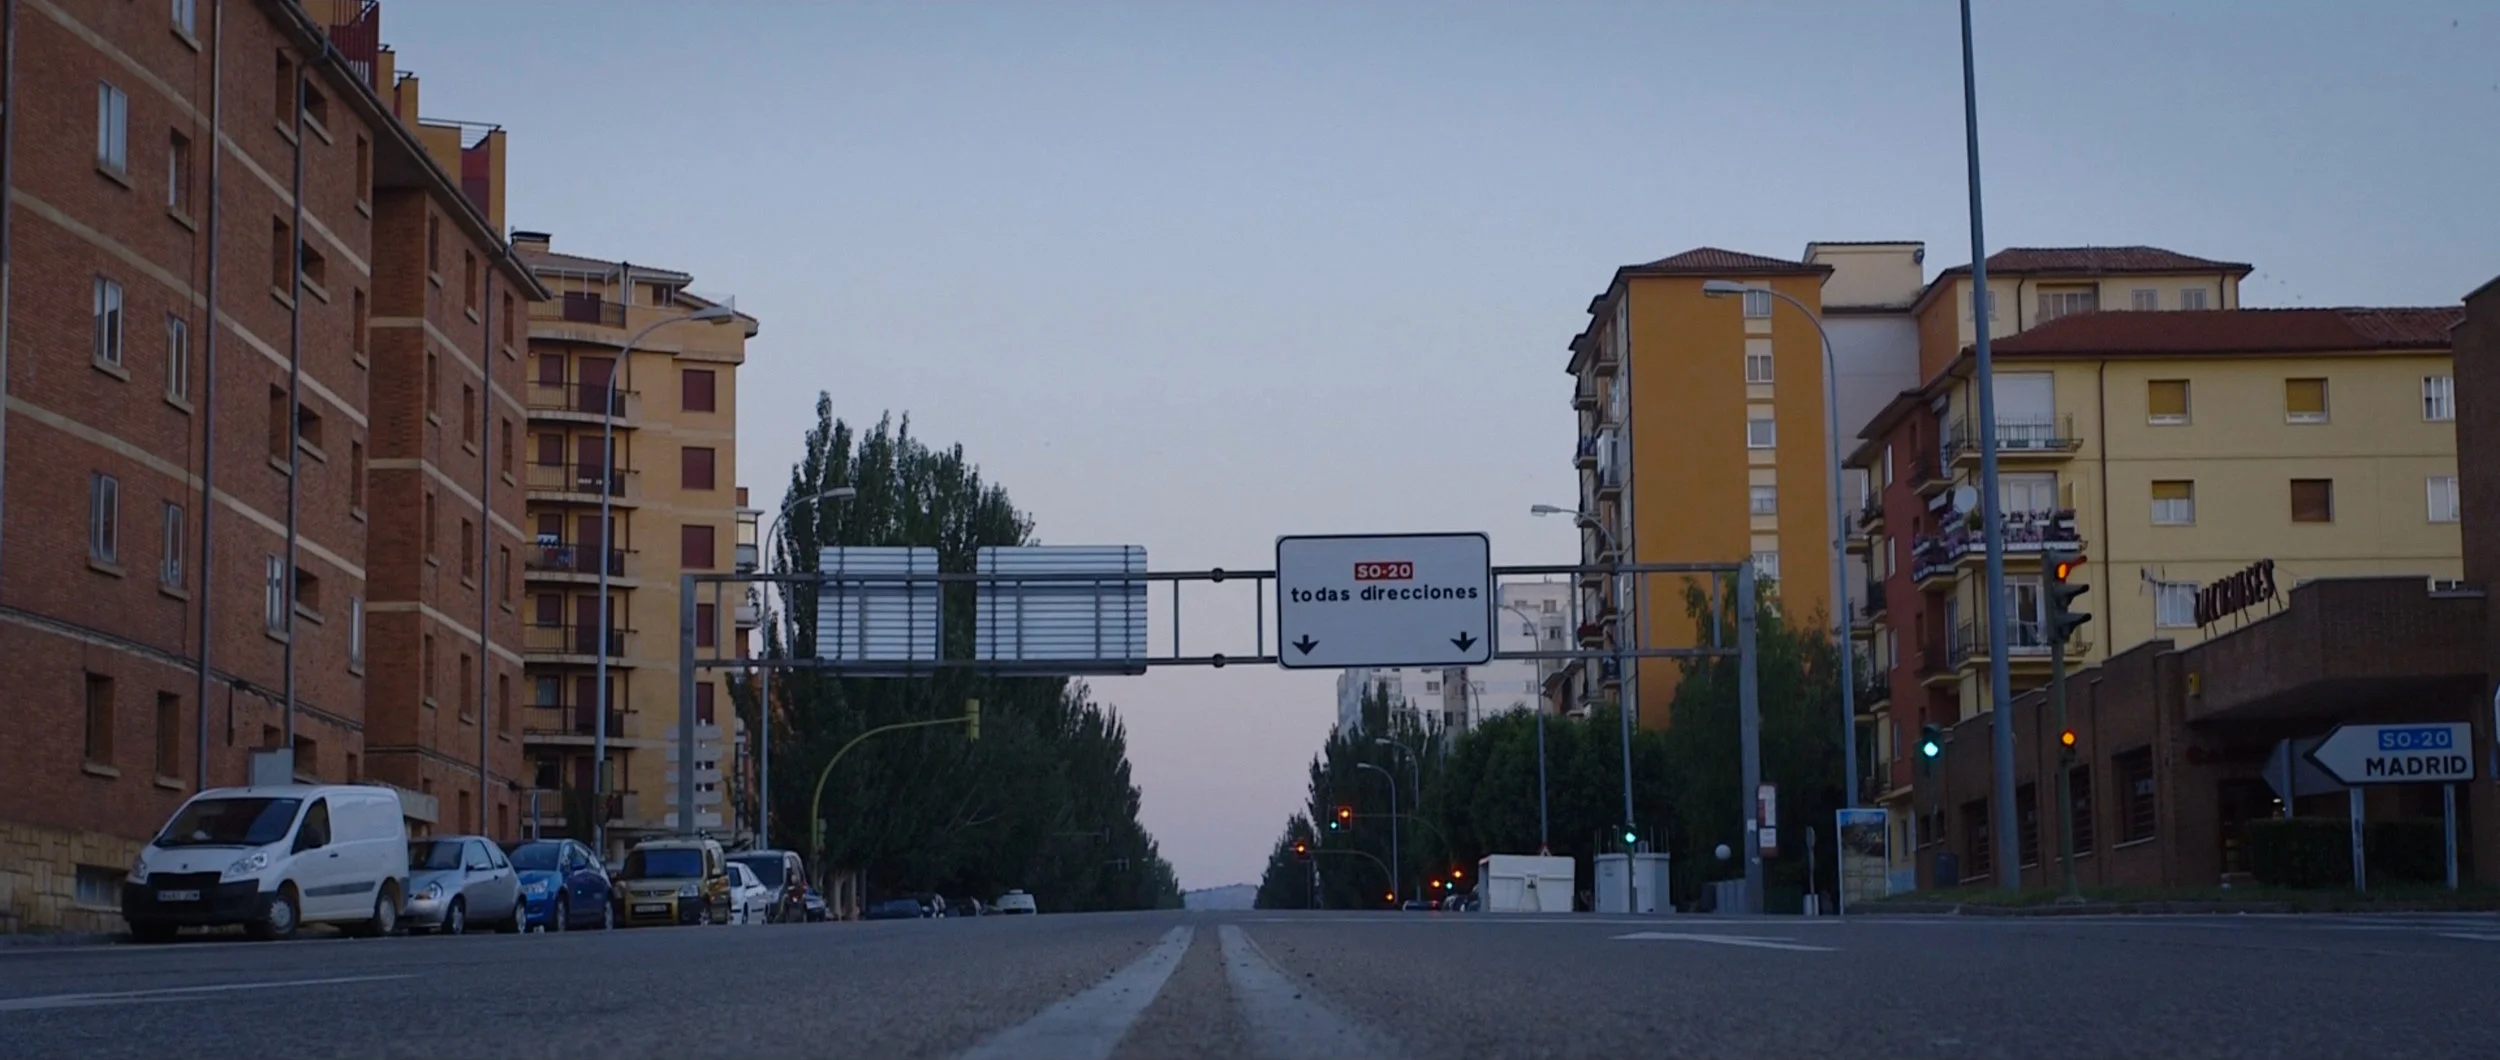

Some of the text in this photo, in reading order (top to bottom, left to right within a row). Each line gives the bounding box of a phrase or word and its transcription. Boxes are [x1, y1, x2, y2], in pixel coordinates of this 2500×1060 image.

[1356, 564, 1412, 578] SO-20
[1291, 585, 1478, 602] todas direcciones
[2381, 730, 2450, 748] SO-20
[2366, 756, 2467, 776] MADRID
